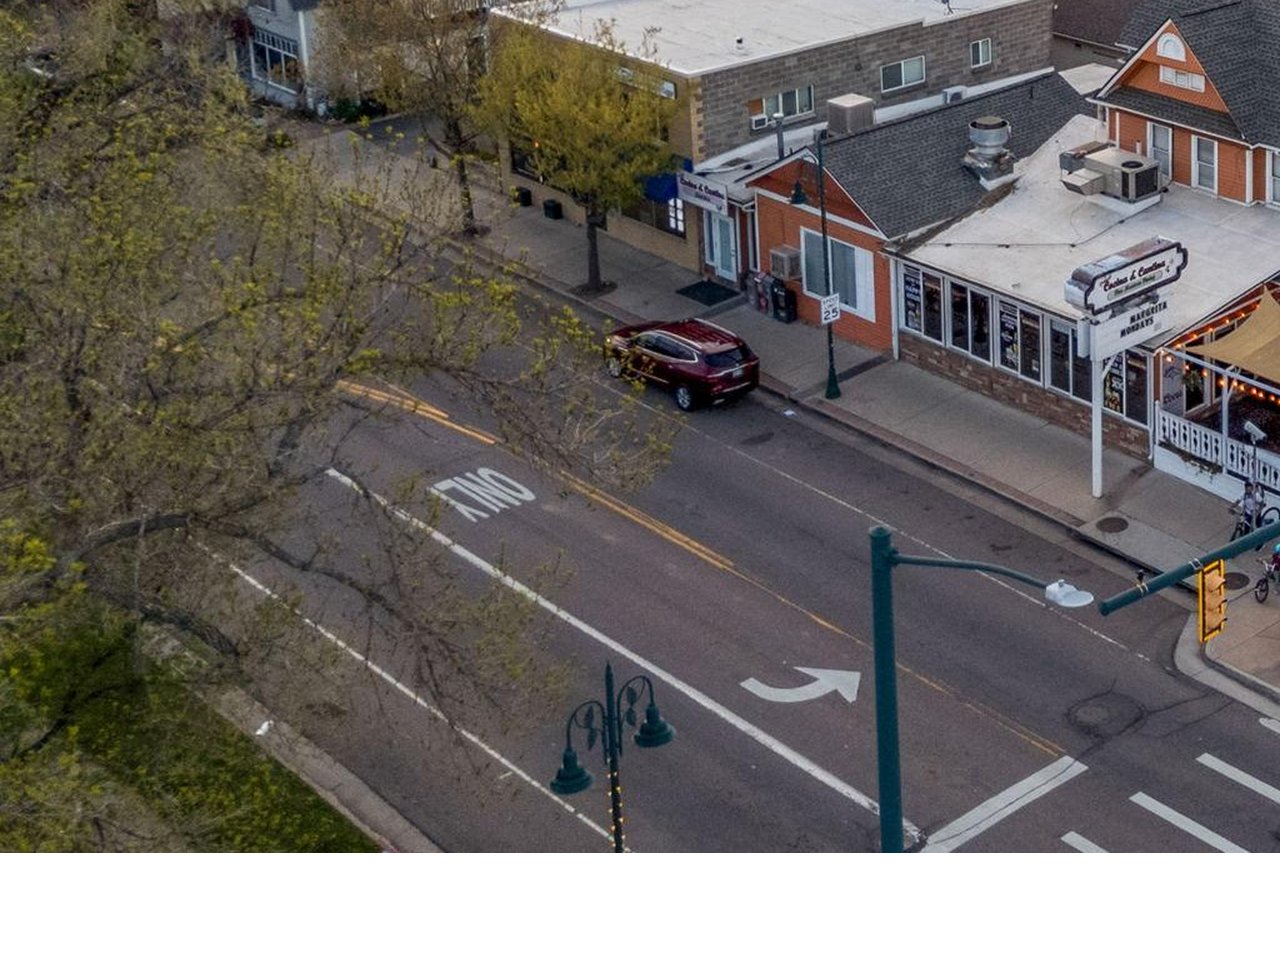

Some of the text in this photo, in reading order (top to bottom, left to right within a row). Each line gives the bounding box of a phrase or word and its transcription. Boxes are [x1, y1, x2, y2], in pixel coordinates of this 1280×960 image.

[824, 307, 839, 321] 25
[1120, 316, 1154, 338] MONDAYS
[427, 467, 537, 522] ONLY
